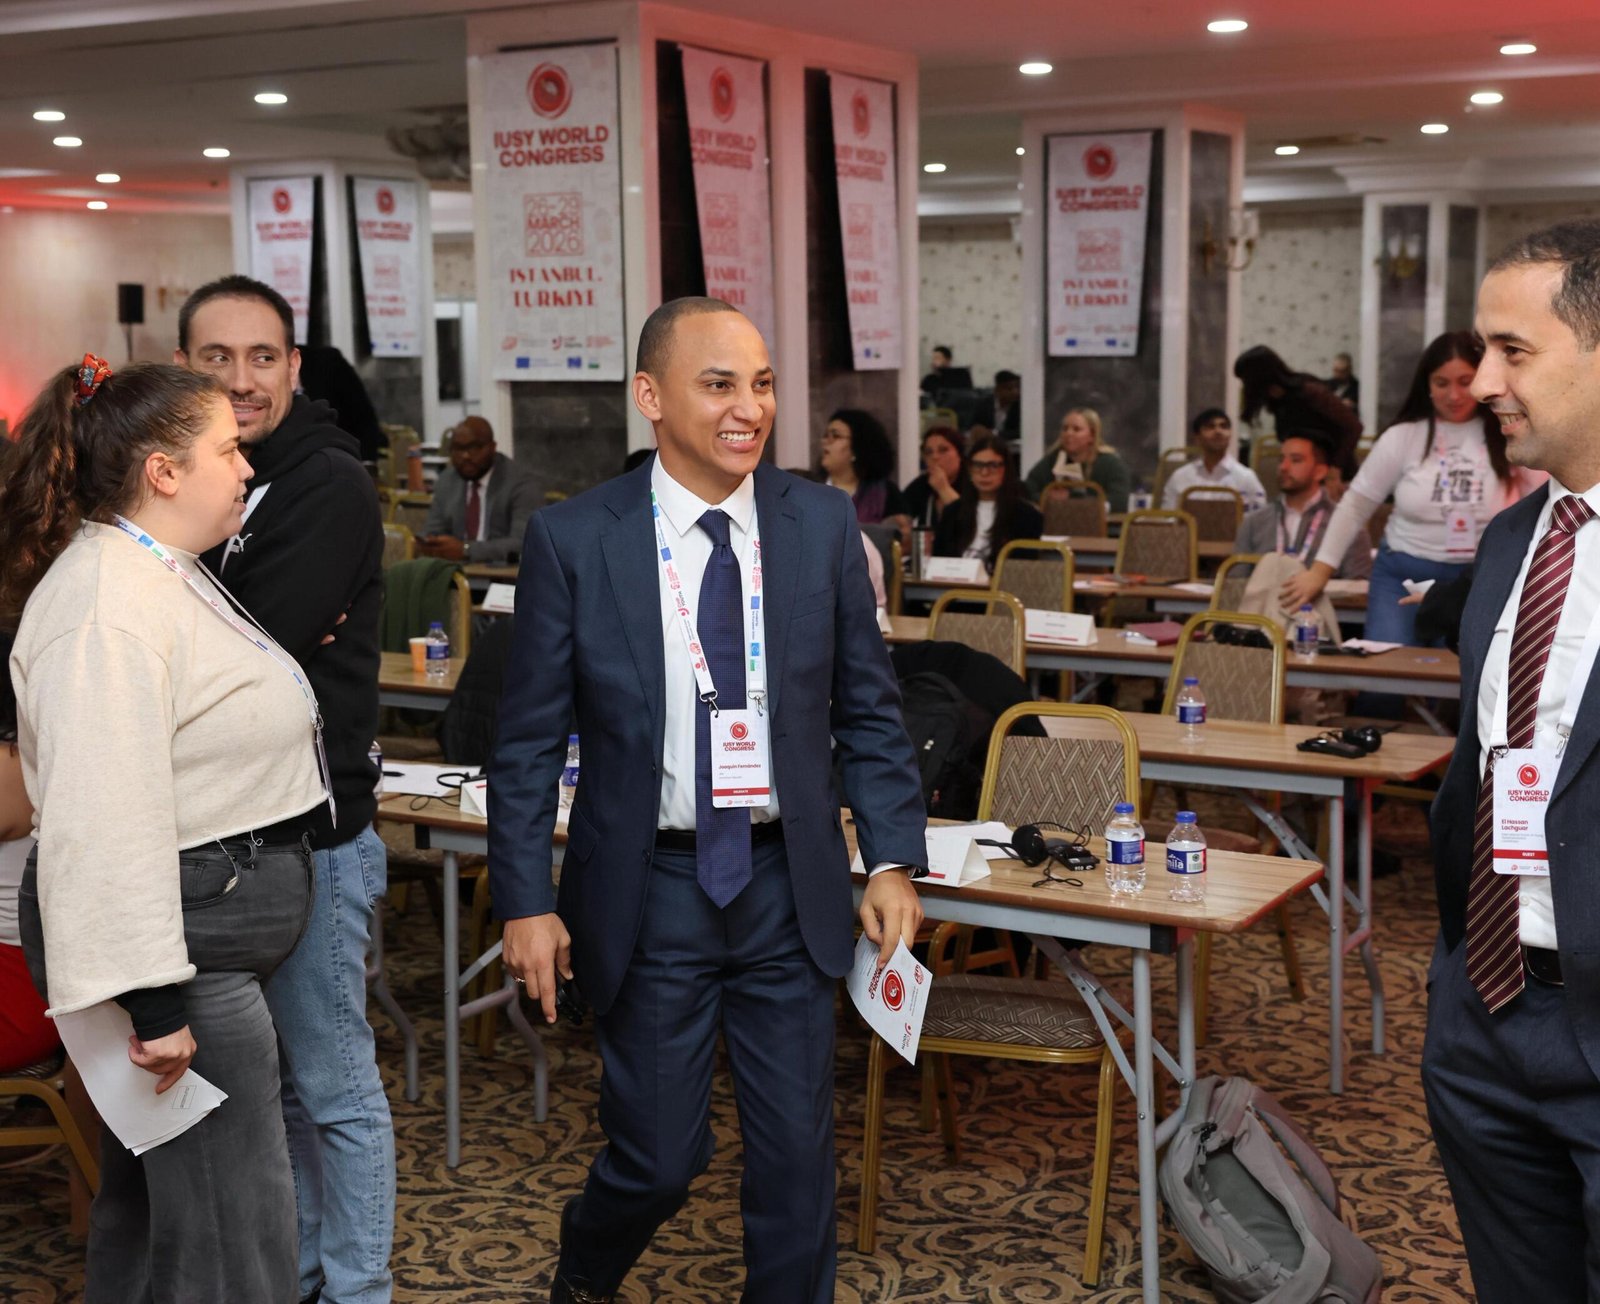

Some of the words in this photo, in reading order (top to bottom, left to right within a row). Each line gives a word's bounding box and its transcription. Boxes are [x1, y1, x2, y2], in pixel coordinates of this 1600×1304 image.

[494, 130, 534, 148] IUSY
[539, 126, 609, 146] WORLD
[499, 145, 605, 168] CONGRESS
[528, 215, 580, 229] MARCH
[529, 231, 580, 252] 2026
